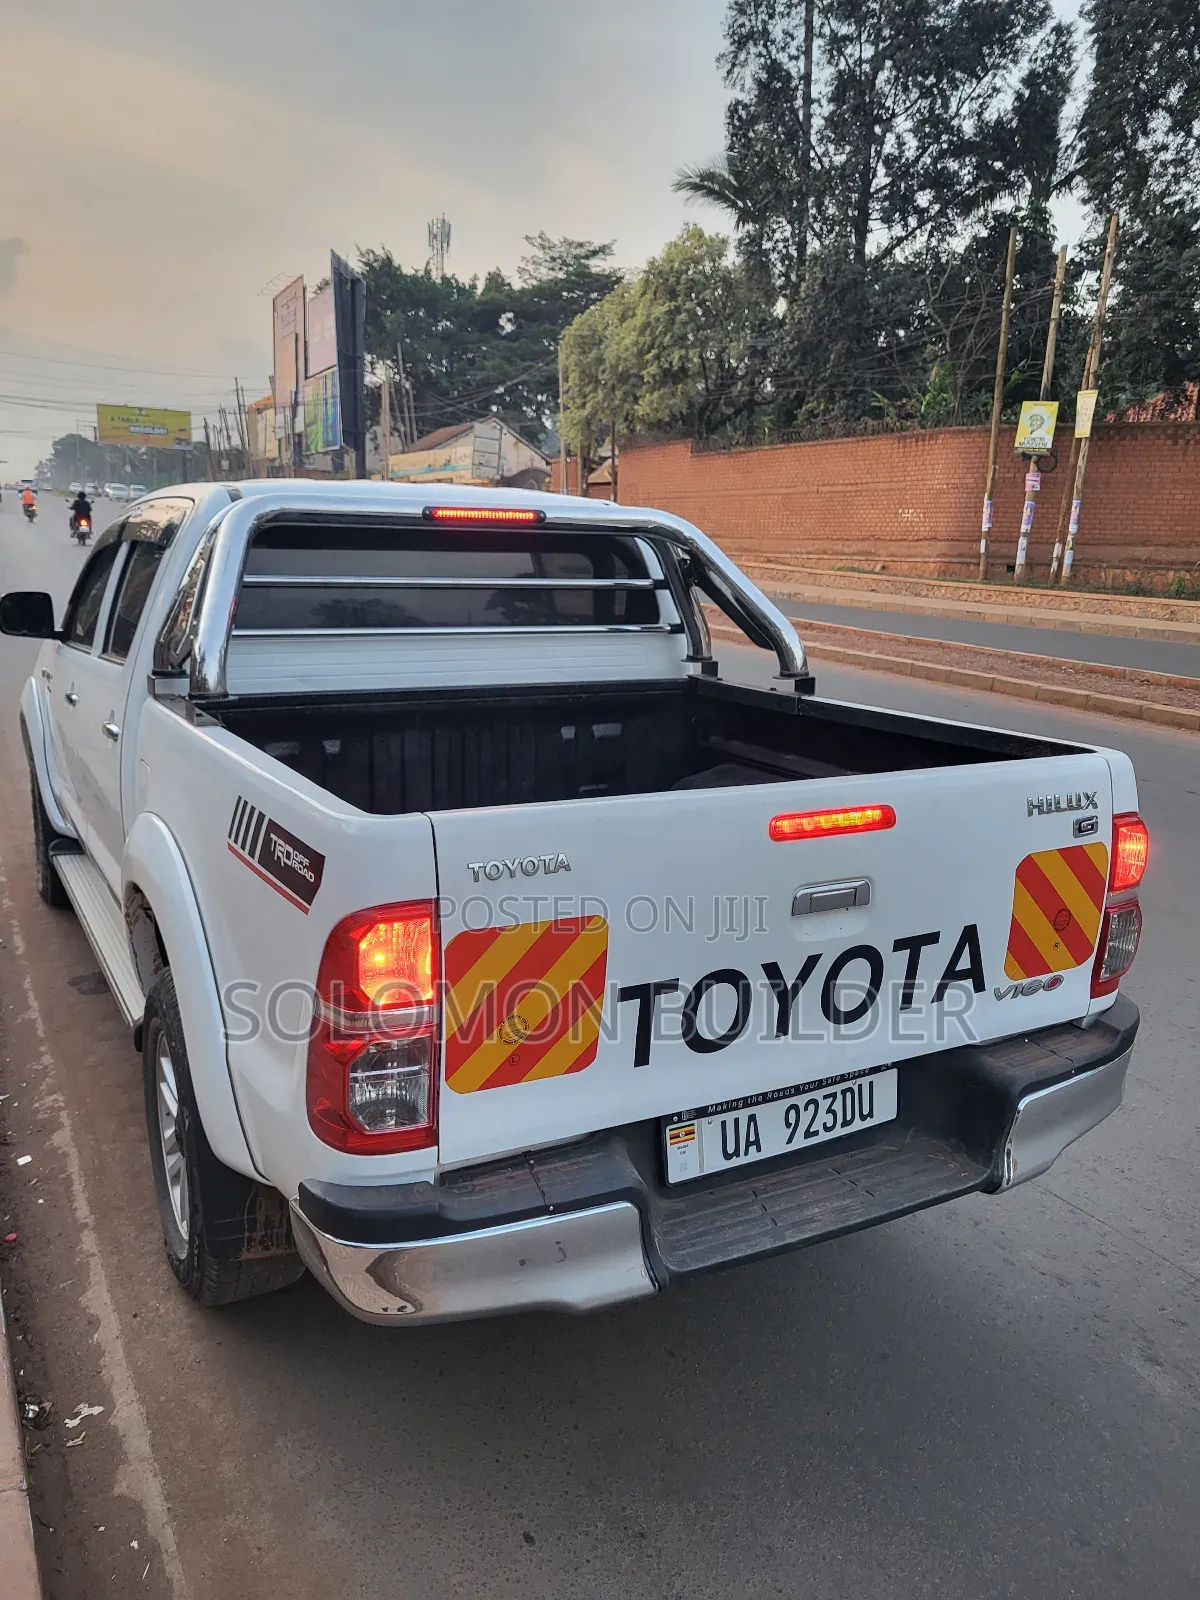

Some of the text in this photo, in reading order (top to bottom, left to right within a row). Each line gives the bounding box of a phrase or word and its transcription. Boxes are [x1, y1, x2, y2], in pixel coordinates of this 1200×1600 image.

[1027, 791, 1098, 817] HILUX
[270, 832, 311, 867] TRD OFF
[292, 859, 315, 883] ROAD
[467, 853, 572, 882] TOYOTA
[617, 923, 987, 1069] TOYOTA
[707, 1067, 870, 1114] Making the Roads Your Safe Space
[720, 1080, 874, 1161] UA 923DU
